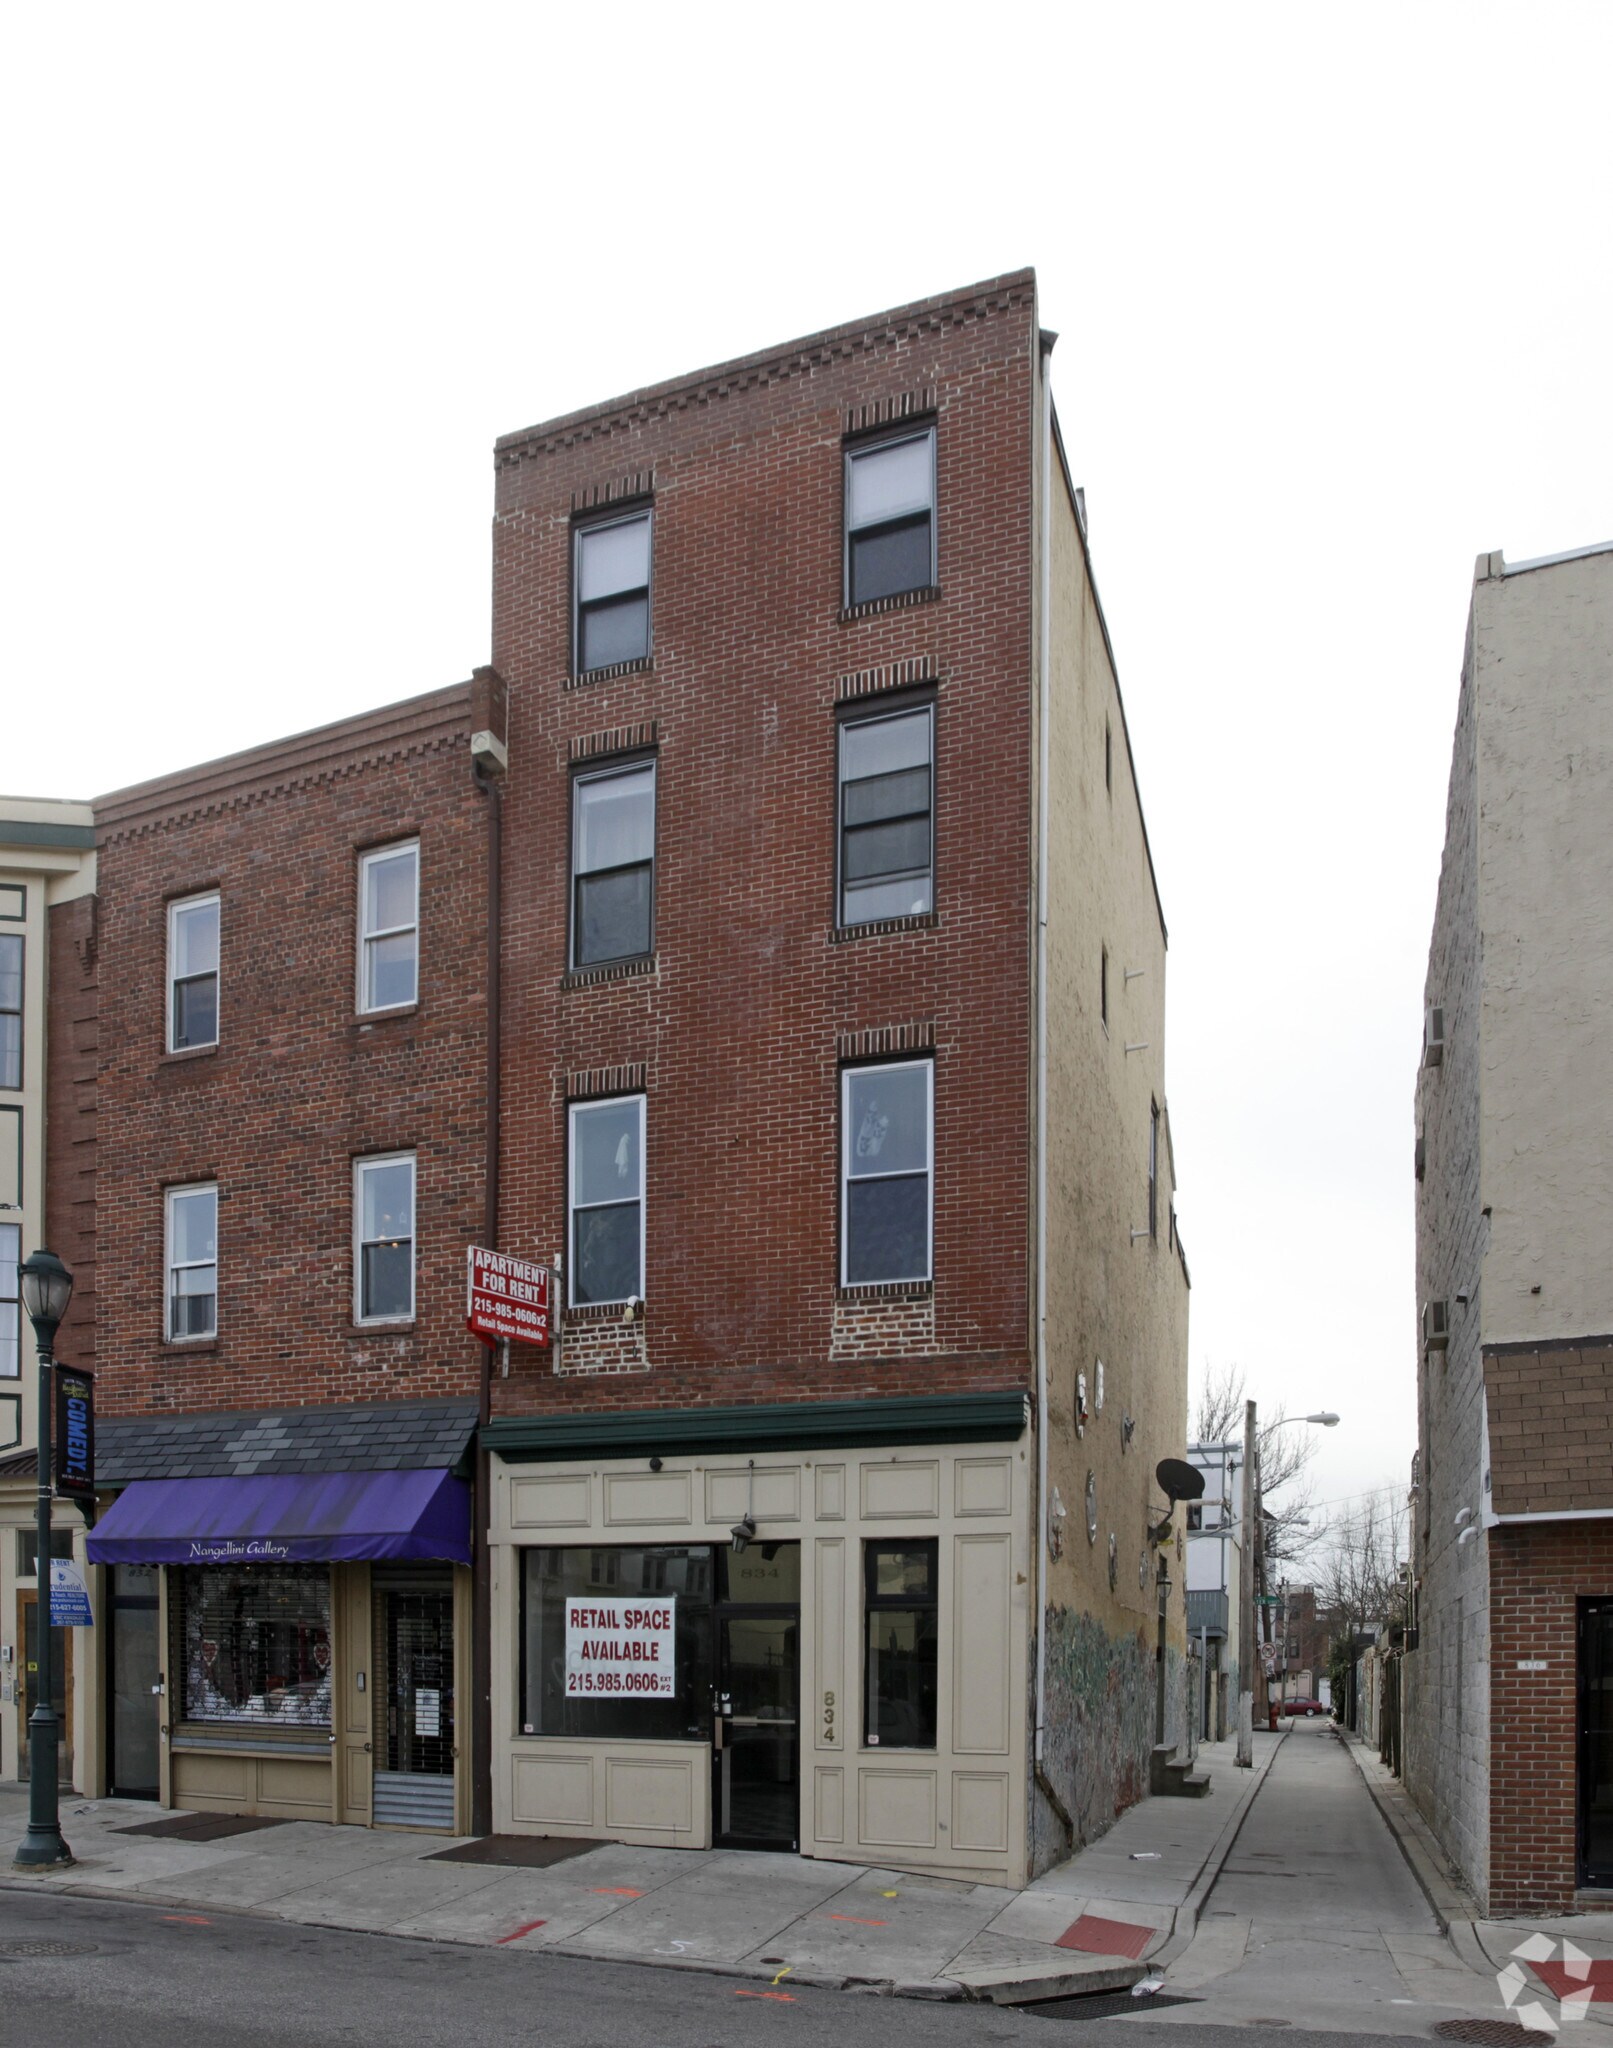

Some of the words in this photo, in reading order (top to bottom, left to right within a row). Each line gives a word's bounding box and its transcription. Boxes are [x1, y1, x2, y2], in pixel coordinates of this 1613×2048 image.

[475, 1250, 546, 1286] APARTMENT
[482, 1271, 506, 1293] FOR
[509, 1279, 540, 1303] RENT
[474, 1296, 547, 1328] 215-985-0606x2
[477, 1315, 496, 1329] Retail
[496, 1320, 516, 1334] Space
[516, 1325, 543, 1341] Available
[189, 1542, 245, 1559] Nangellini
[246, 1541, 289, 1558] Gallery
[740, 1568, 779, 1578] 834
[50, 1582, 82, 1591] rudential
[570, 1608, 620, 1629] RETAIL
[624, 1609, 671, 1630] SPACE
[581, 1640, 659, 1661] AVAILABLE
[568, 1672, 659, 1692] 215.985.0606
[660, 1684, 671, 1692] #2
[823, 1690, 835, 1743] 834
